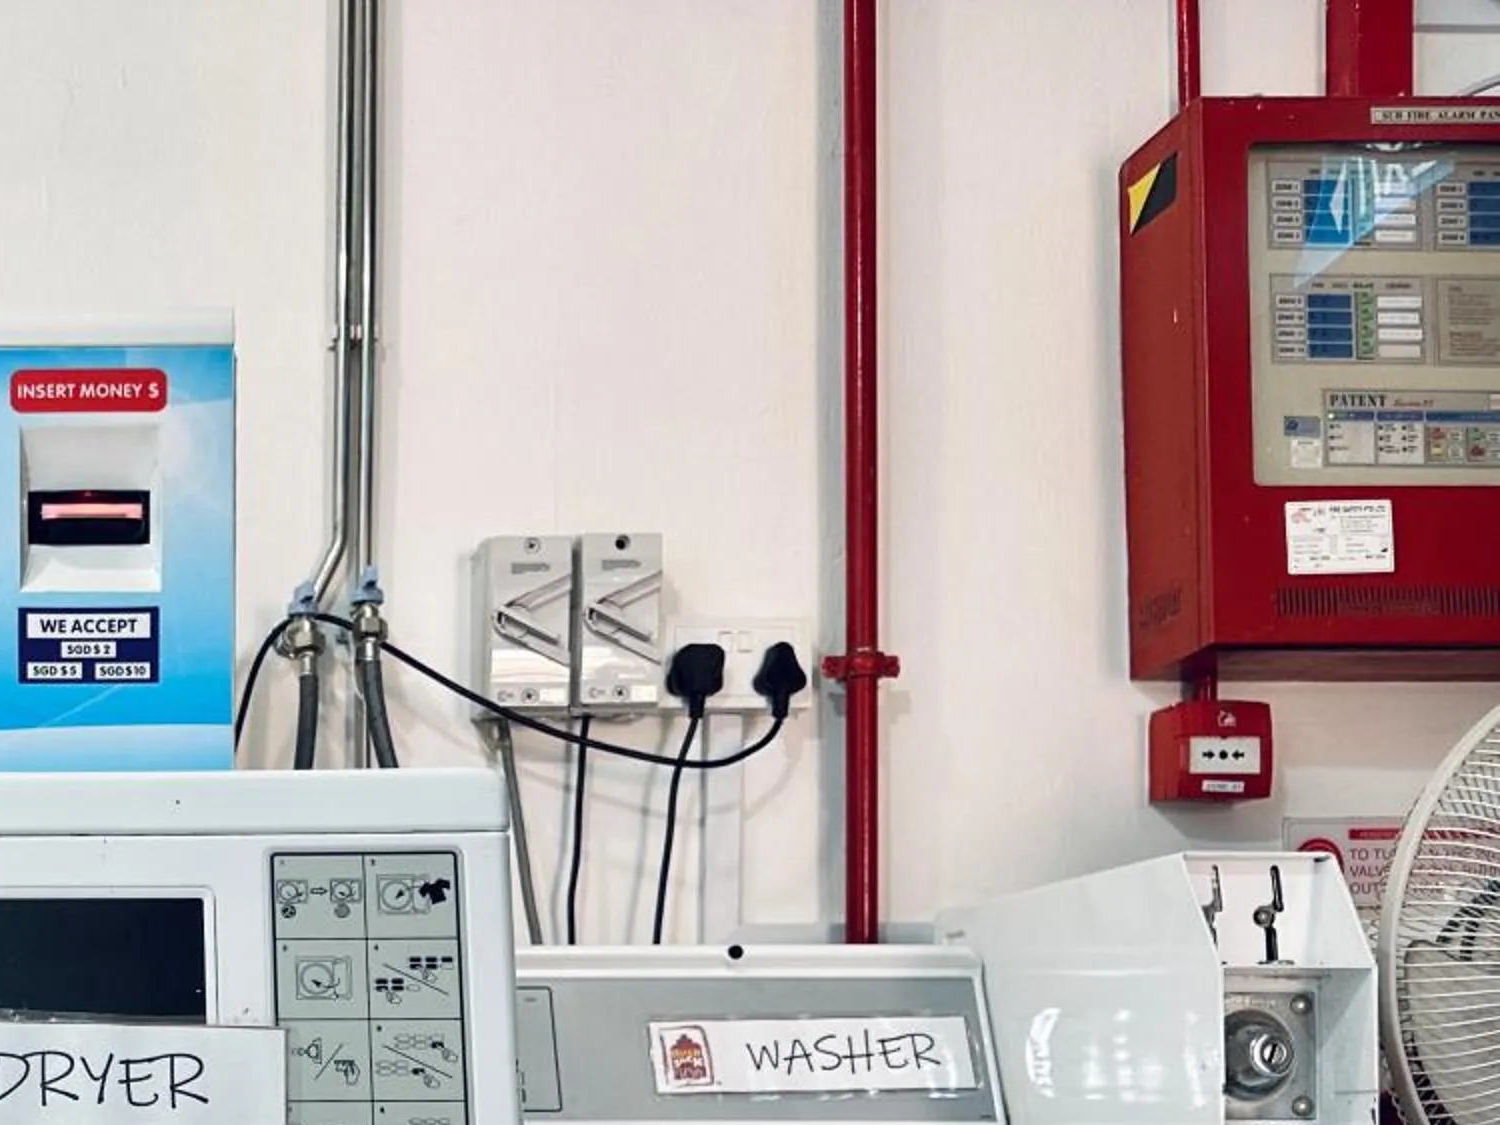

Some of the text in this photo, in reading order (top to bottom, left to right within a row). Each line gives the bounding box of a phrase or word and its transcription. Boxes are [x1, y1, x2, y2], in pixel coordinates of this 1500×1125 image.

[16, 383, 76, 399] INSERT
[79, 383, 143, 399] MONEY
[1328, 394, 1387, 408] PATENT
[39, 619, 138, 633] WE ACCEPT
[67, 644, 91, 655] SGD
[33, 665, 58, 676] SGD
[746, 1029, 942, 1076] WASHER
